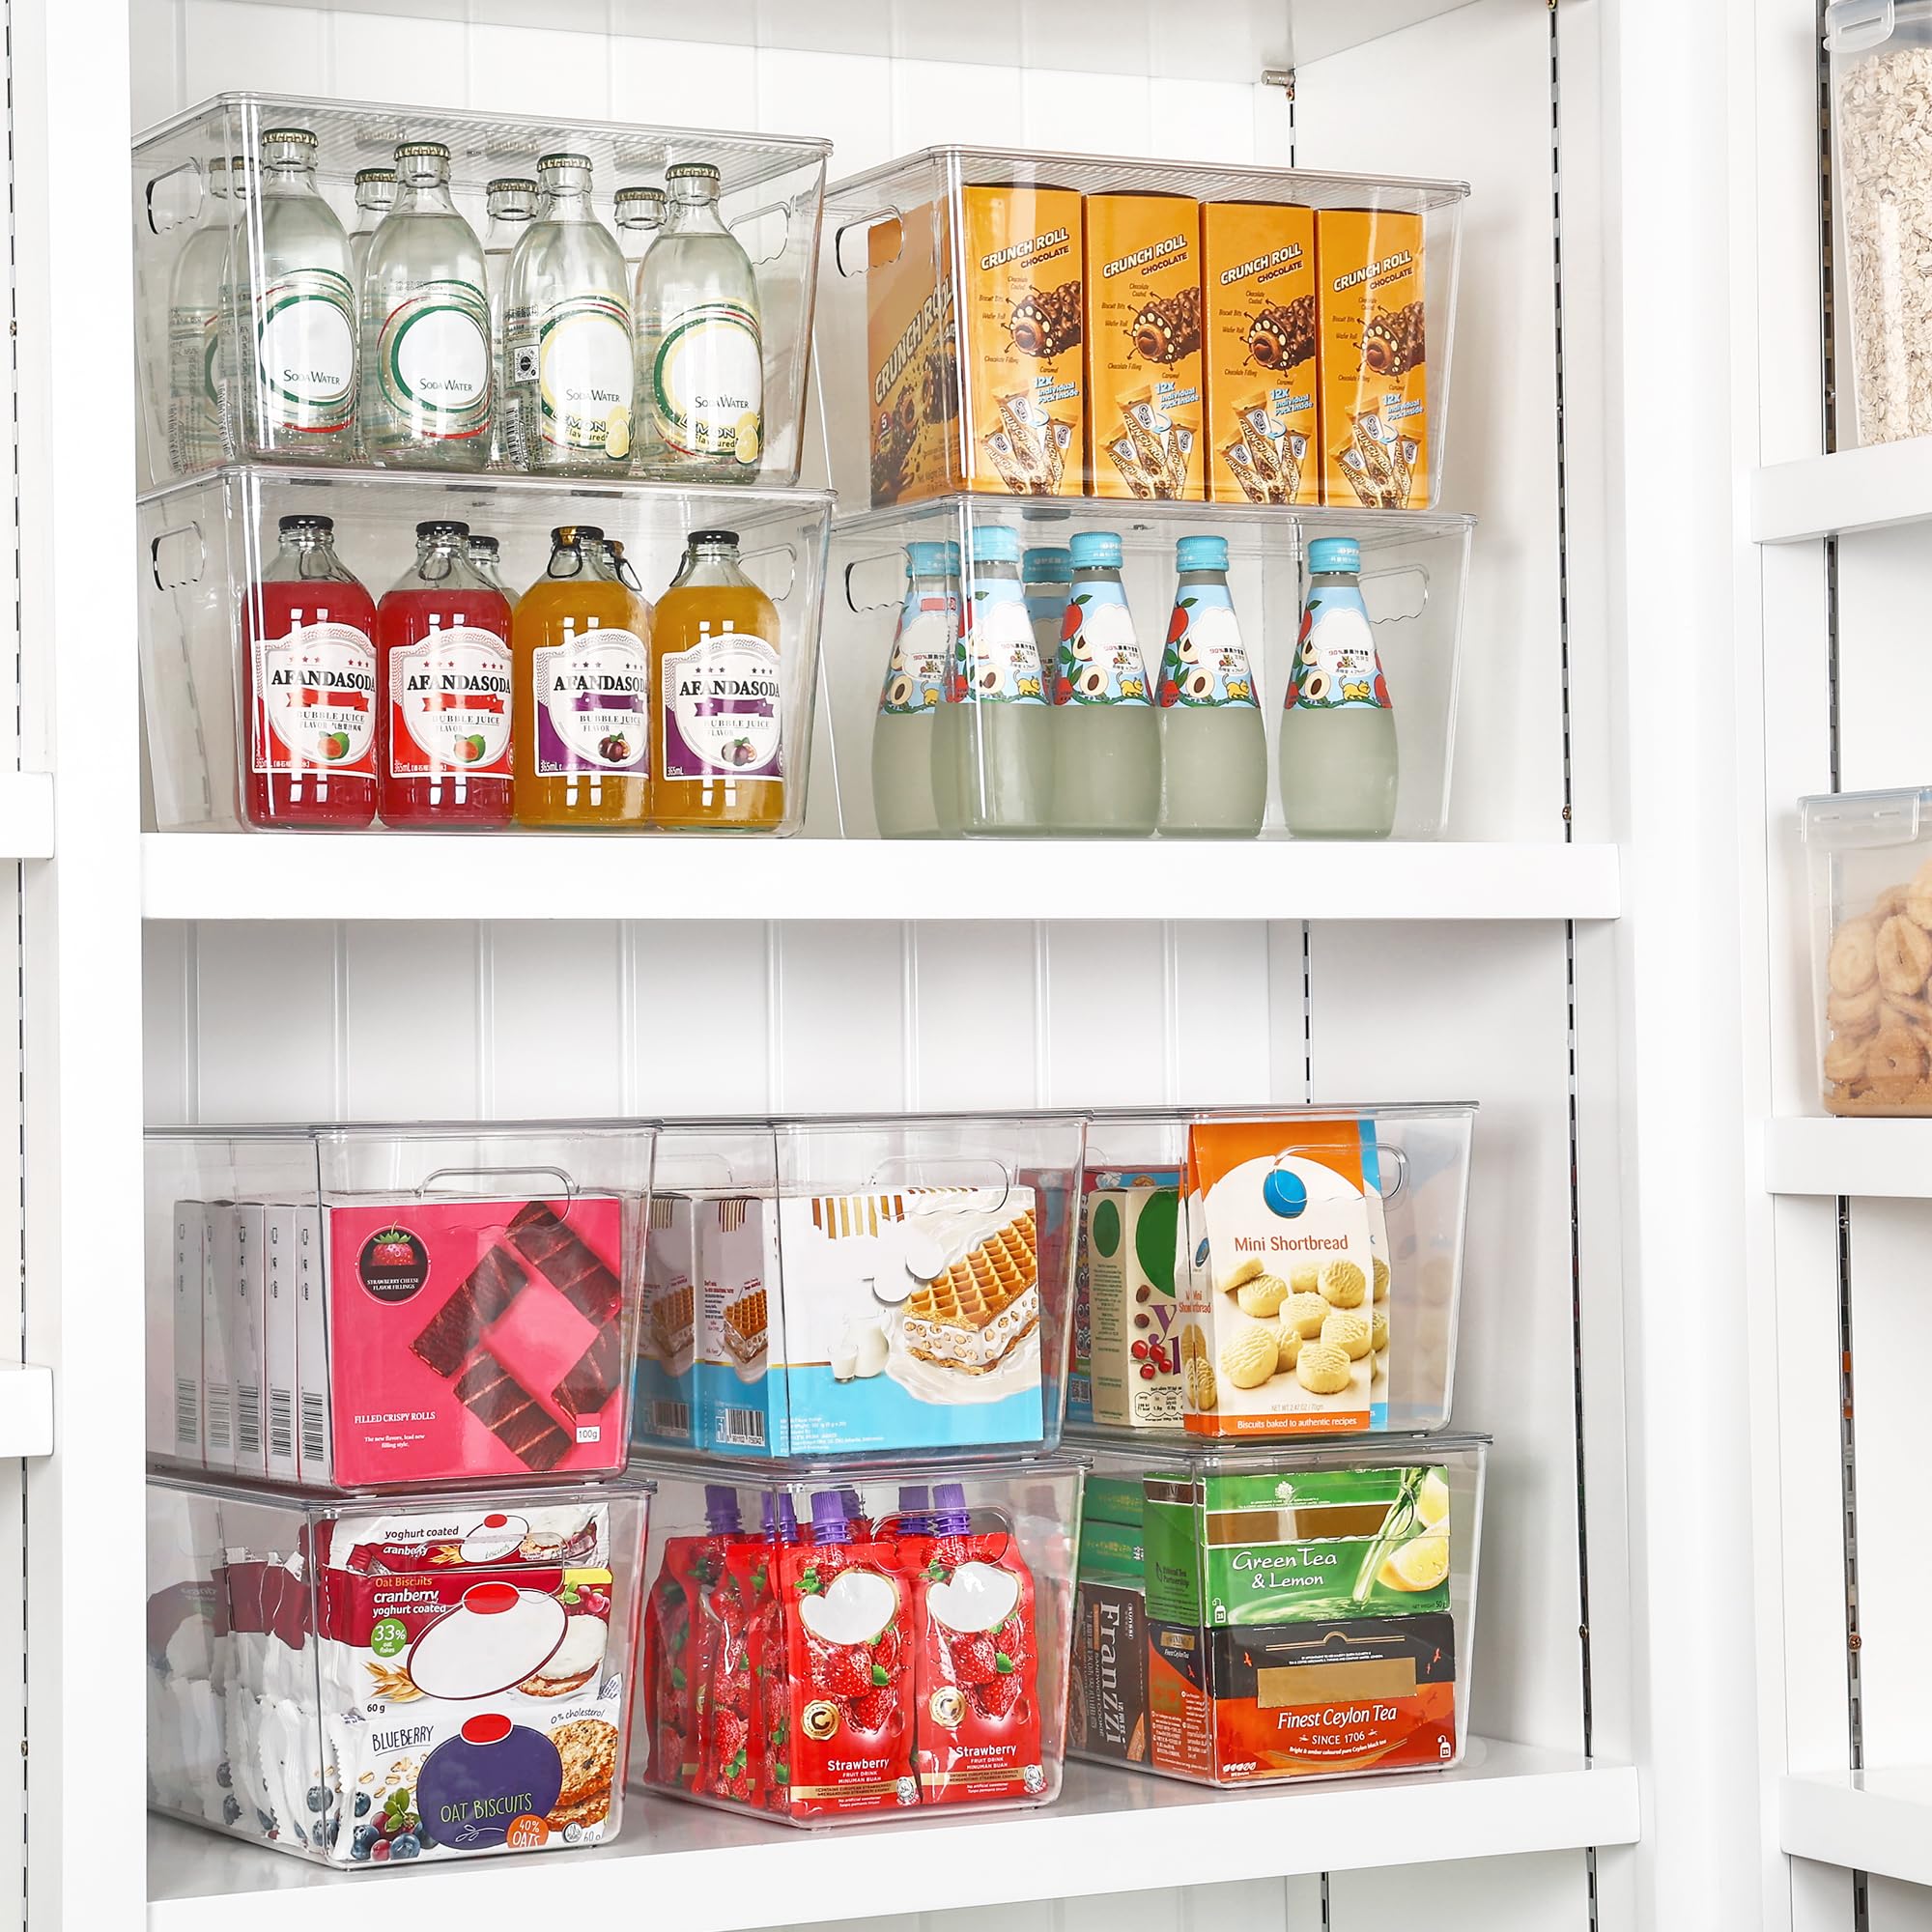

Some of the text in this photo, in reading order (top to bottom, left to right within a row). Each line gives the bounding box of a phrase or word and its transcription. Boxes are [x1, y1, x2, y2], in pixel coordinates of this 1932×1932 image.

[980, 227, 1069, 270] CRUNCH ROLL
[1020, 245, 1069, 268] CHOCOLATE
[1102, 234, 1188, 278] CRUNCH ROLL
[1141, 252, 1188, 275] CHOCOLATE
[1220, 242, 1303, 286] CRUNCH ROLL
[1257, 260, 1303, 283] CHOCOLATE
[1333, 249, 1412, 293] CRUNCH ROLL
[1369, 268, 1412, 290] CHOCOLATE
[875, 277, 952, 406] CRUNCH ROLL
[551, 410, 607, 433] LMON
[680, 412, 736, 439] LMON
[407, 675, 511, 694] AFANDASODA
[679, 680, 780, 697] AFANDASODA
[341, 713, 364, 723] JUICE
[476, 716, 499, 724] JUICE
[1235, 1235, 1349, 1251] Mini Shortbread
[355, 1411, 436, 1424] FILLED CRISPY ROLLS
[1237, 1420, 1264, 1429] Biscuits
[1266, 1419, 1288, 1428] baked
[1332, 1417, 1357, 1427] recipes
[579, 1430, 598, 1439] 100g
[384, 1525, 459, 1540] yoghurt coated
[1233, 1548, 1337, 1571] Green Tea
[375, 1576, 433, 1587] Oat Biscuits
[1251, 1572, 1323, 1589] & Lemon
[374, 1588, 439, 1603] cranberry
[373, 1604, 446, 1618] yoghurt coated
[374, 1625, 406, 1641] 33%
[1100, 1601, 1125, 1744] Franzzi
[367, 1703, 385, 1714] 60 g
[565, 1709, 605, 1719] cholesterol
[1277, 1704, 1397, 1729] Finest Ceylon Tea
[372, 1725, 434, 1751] BLUEBERRY
[1312, 1731, 1365, 1745] SINCE 1706
[956, 1745, 1016, 1757] Strawberry
[828, 1758, 889, 1772] Strawberry
[440, 1792, 532, 1823] OAT BISCUITS
[519, 1820, 539, 1833] 40%
